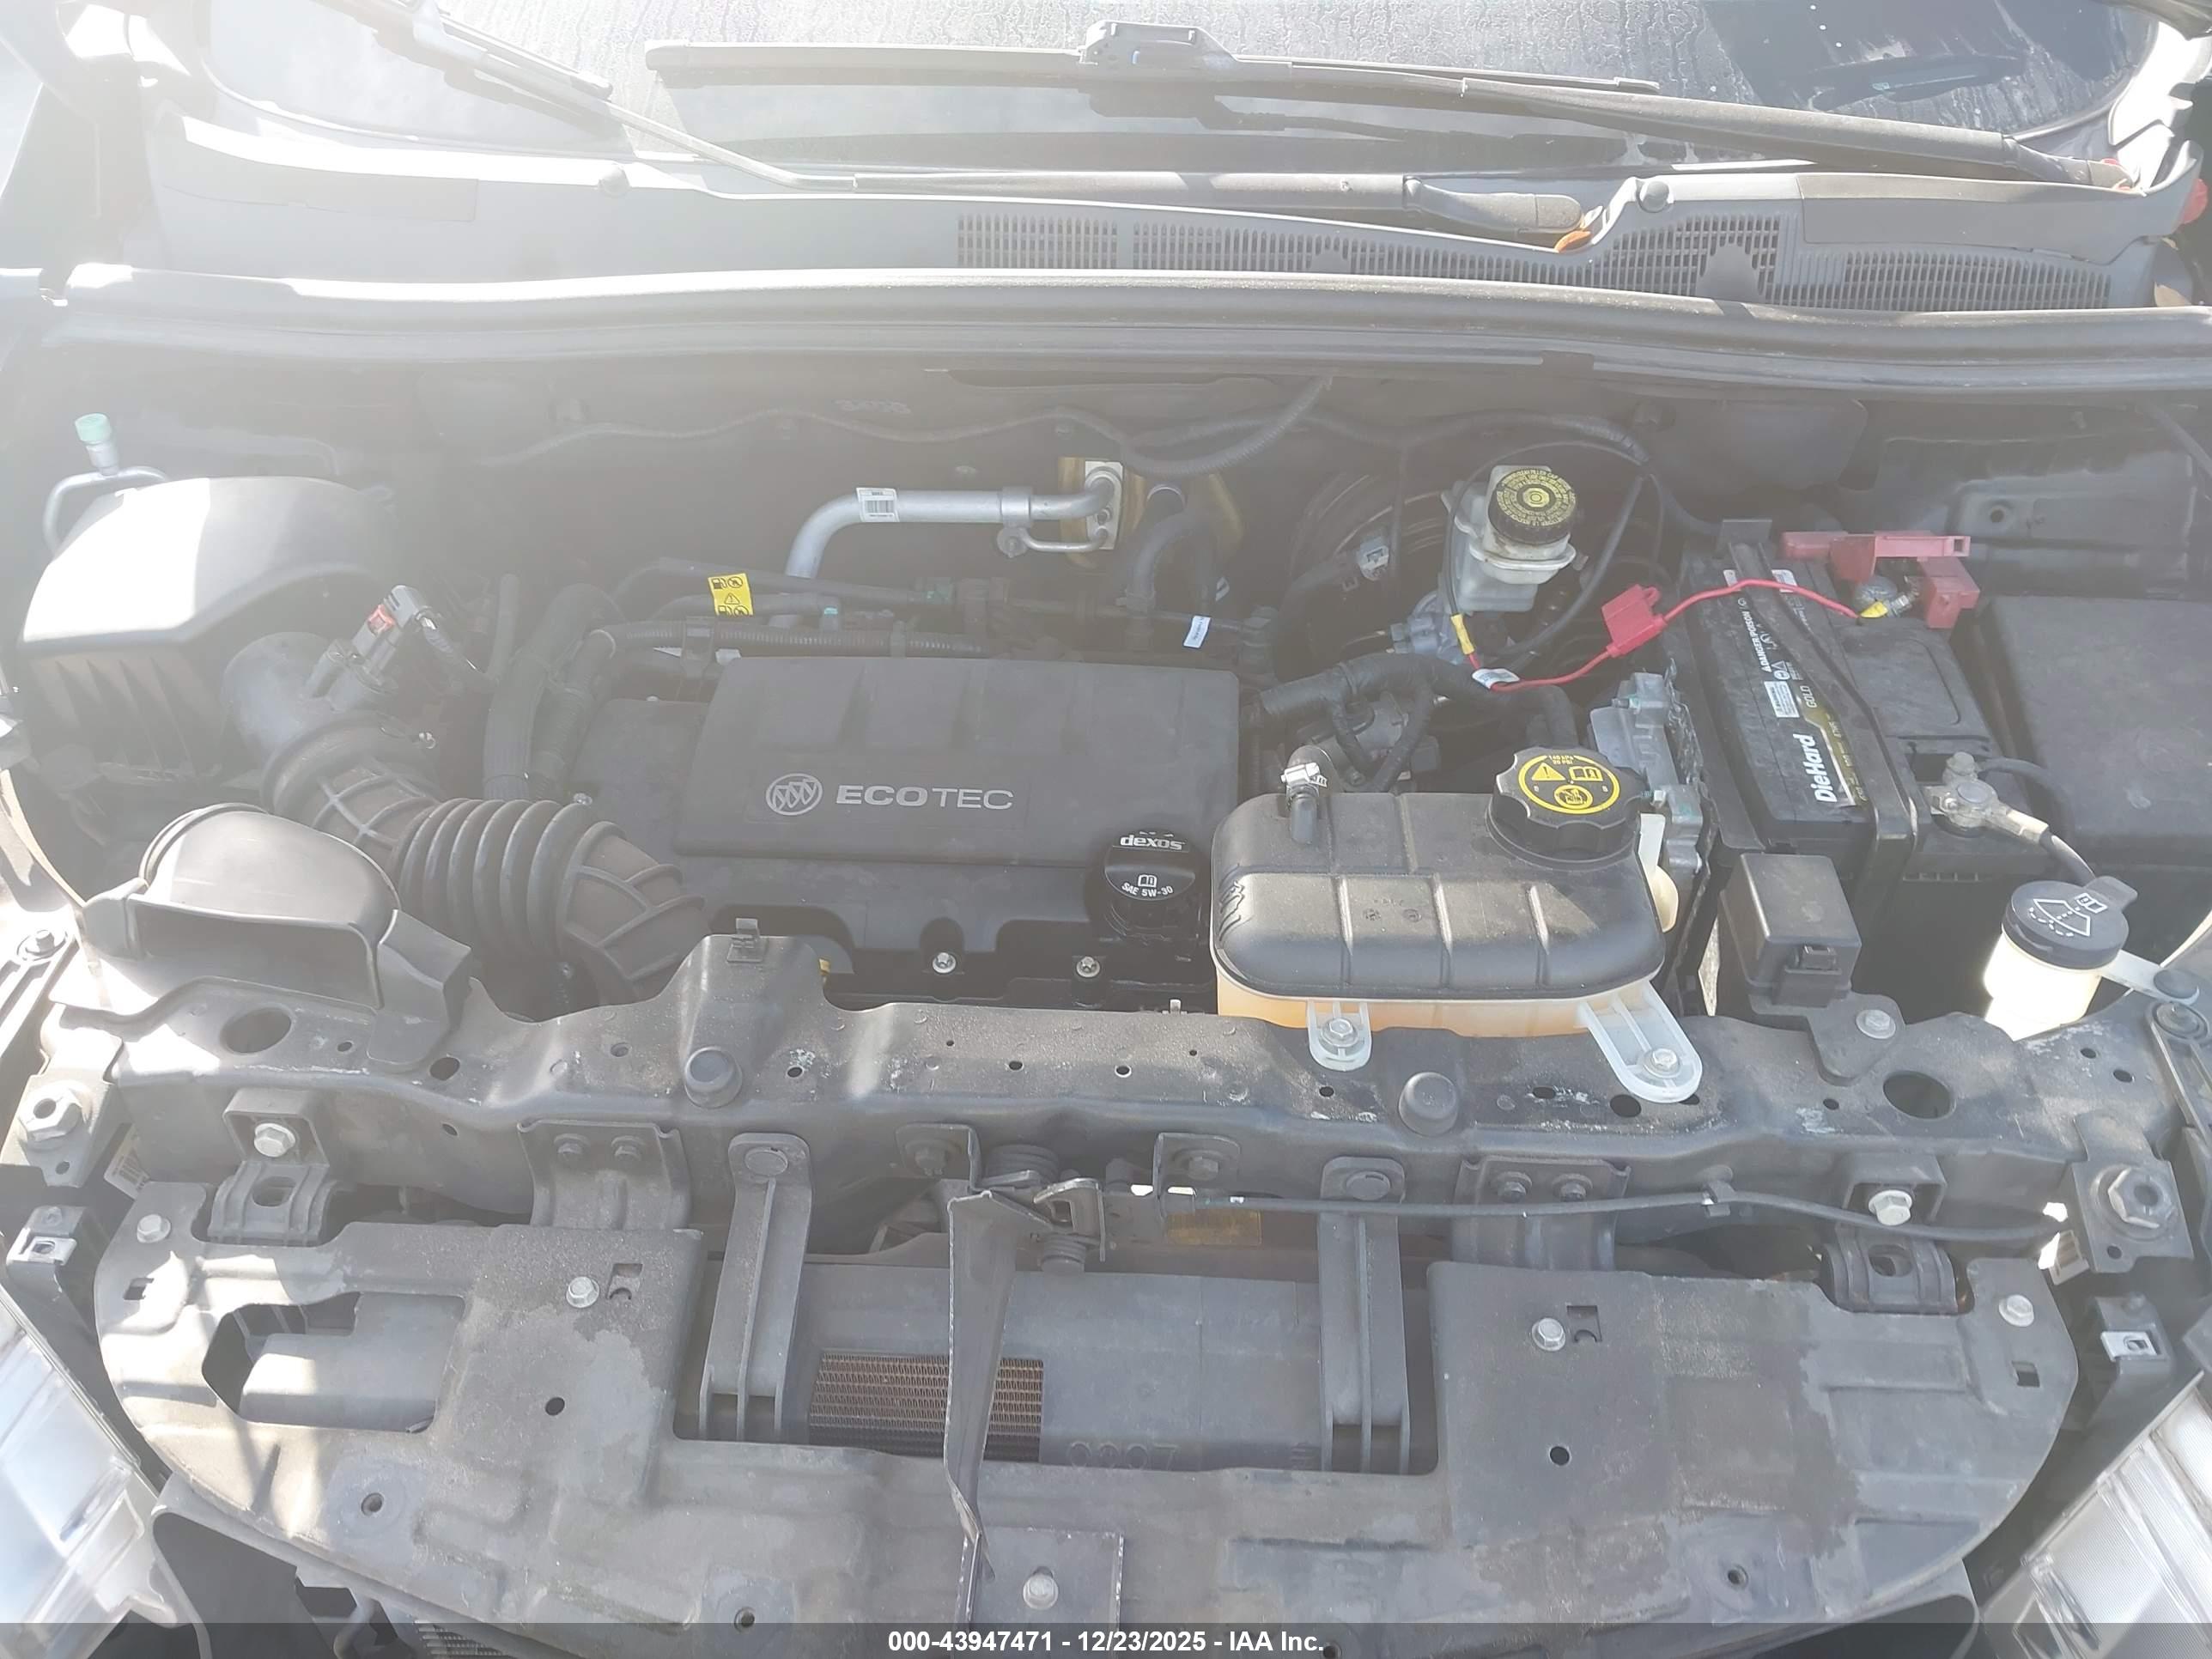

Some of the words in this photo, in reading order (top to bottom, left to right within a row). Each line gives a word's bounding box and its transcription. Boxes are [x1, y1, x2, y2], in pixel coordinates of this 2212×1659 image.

[1800, 685, 1818, 708] GOLD
[1792, 733, 1838, 802] DieHard
[836, 785, 1014, 810] ECOTEC
[1120, 835, 1182, 850] dexos
[1121, 882, 1139, 896] SAE
[1141, 885, 1174, 897] 5W-30
